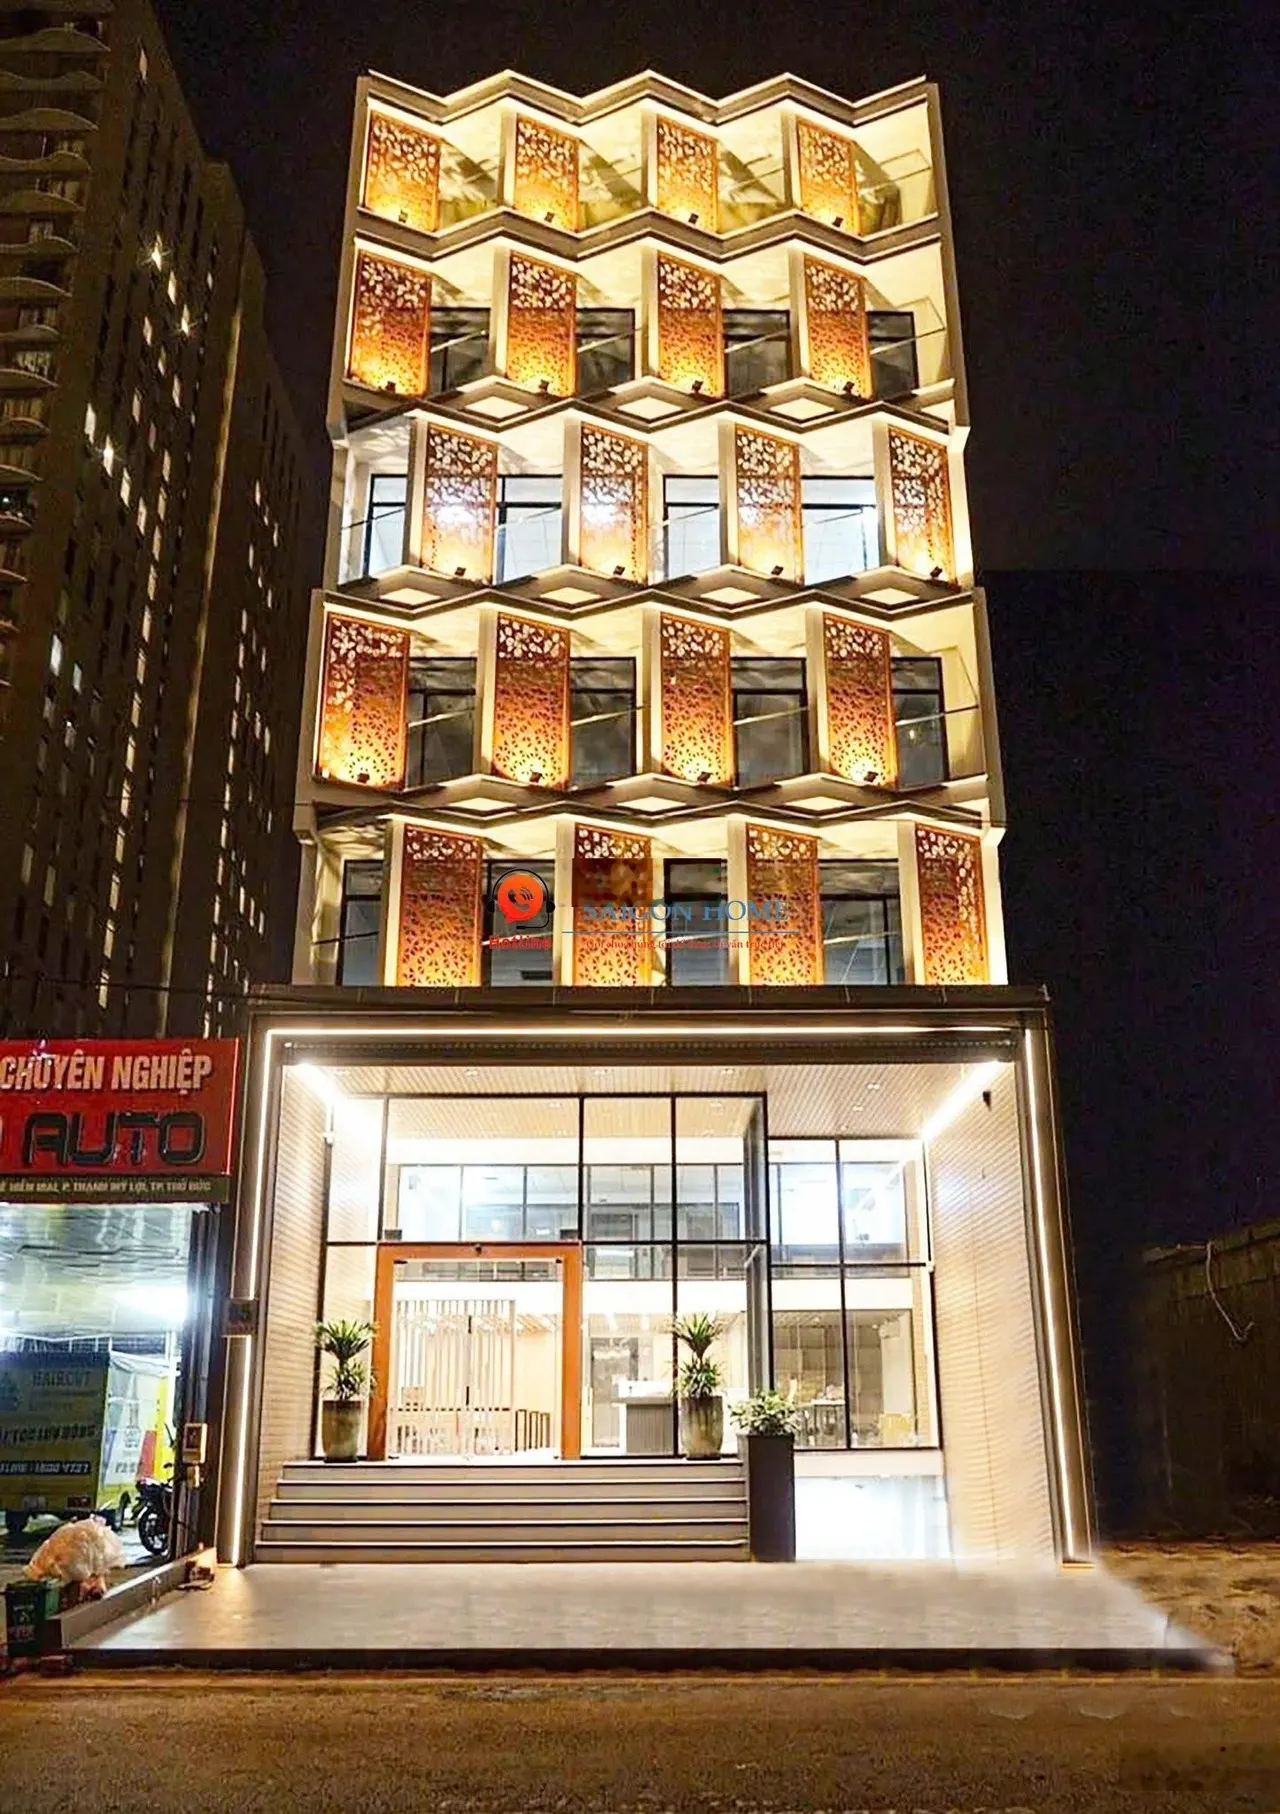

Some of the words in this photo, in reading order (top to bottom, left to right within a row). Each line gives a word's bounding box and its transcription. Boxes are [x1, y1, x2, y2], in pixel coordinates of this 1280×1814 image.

[0, 1049, 105, 1091] CHUYÊN
[111, 1048, 213, 1095] NGHIỆP
[25, 1111, 204, 1165] AUTO
